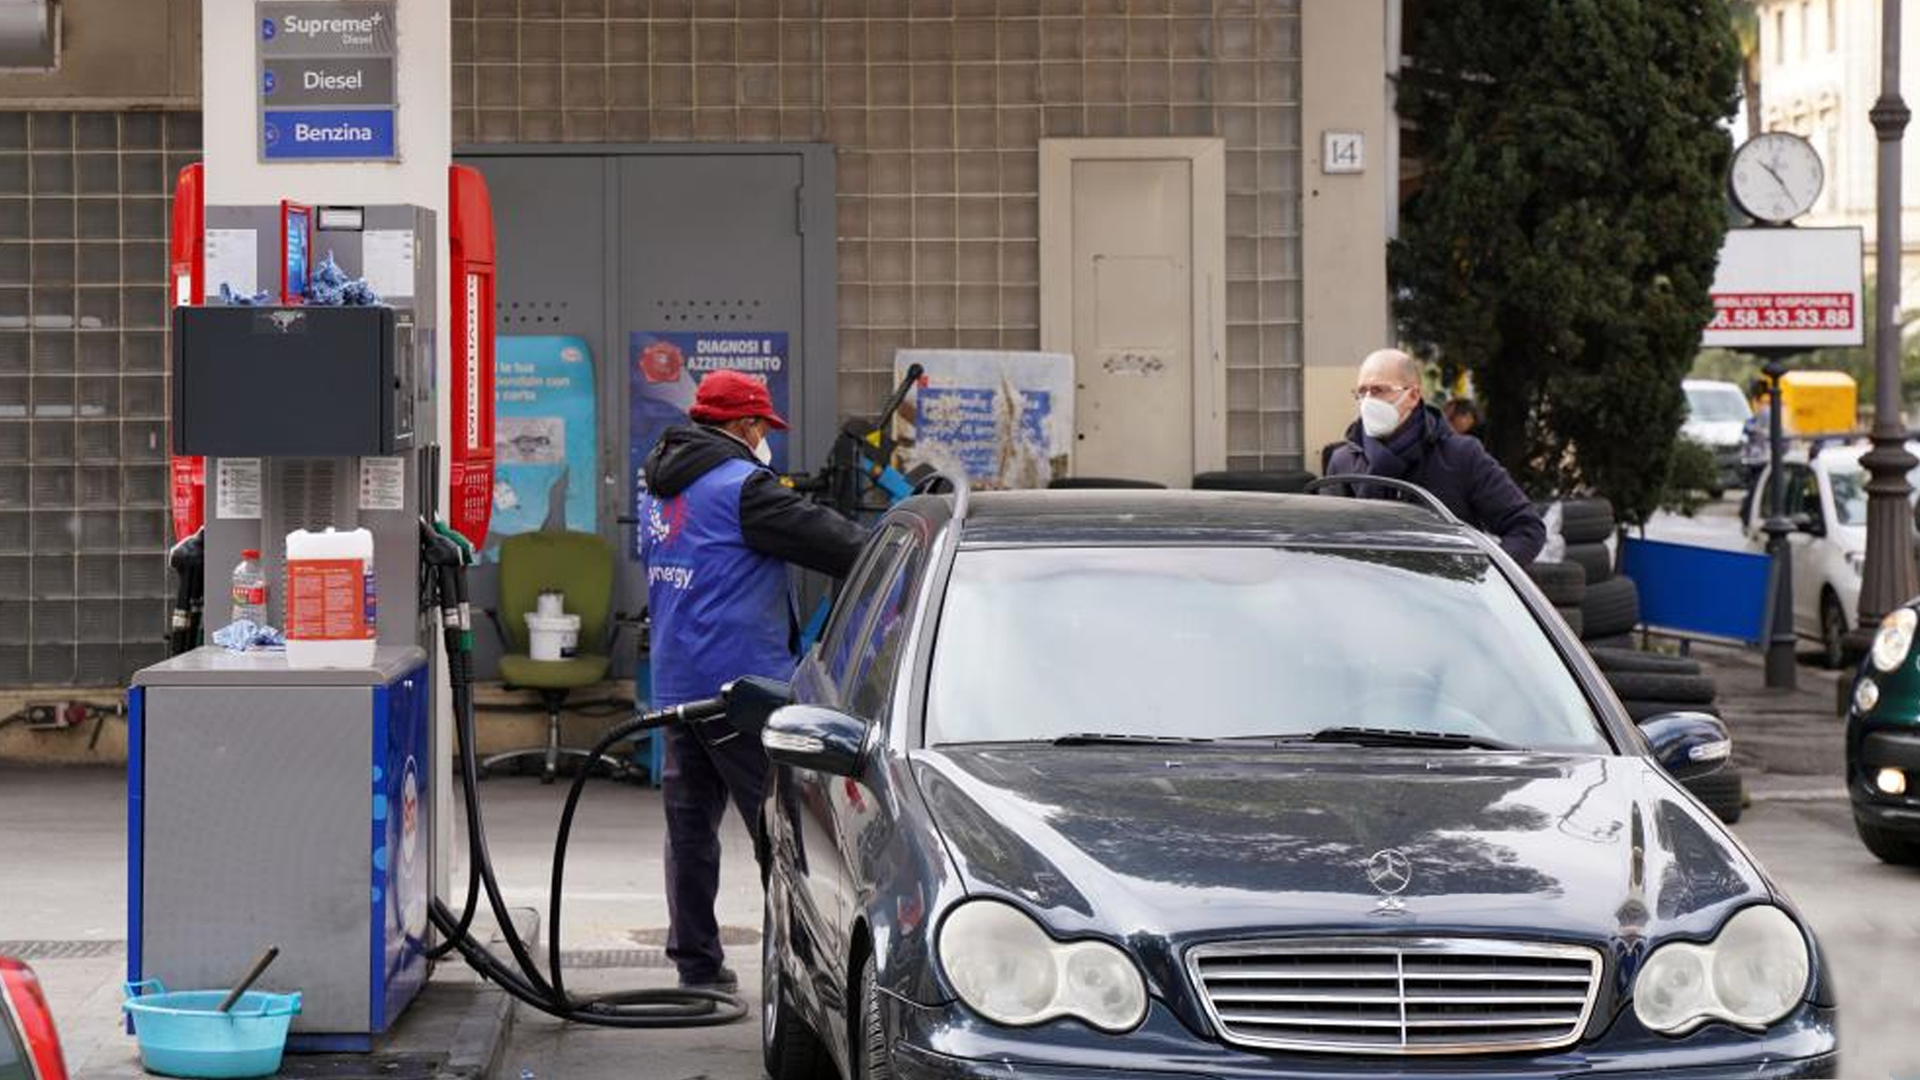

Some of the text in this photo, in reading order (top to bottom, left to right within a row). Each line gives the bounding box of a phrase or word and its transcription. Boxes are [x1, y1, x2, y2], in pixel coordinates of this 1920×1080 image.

[342, 34, 372, 45] Diesel
[303, 70, 362, 90] Diesel
[295, 123, 373, 142] Benzina
[1332, 139, 1358, 164] 14
[696, 339, 772, 354] DIAGNOSI E
[687, 356, 781, 372] AZZERAMENTO
